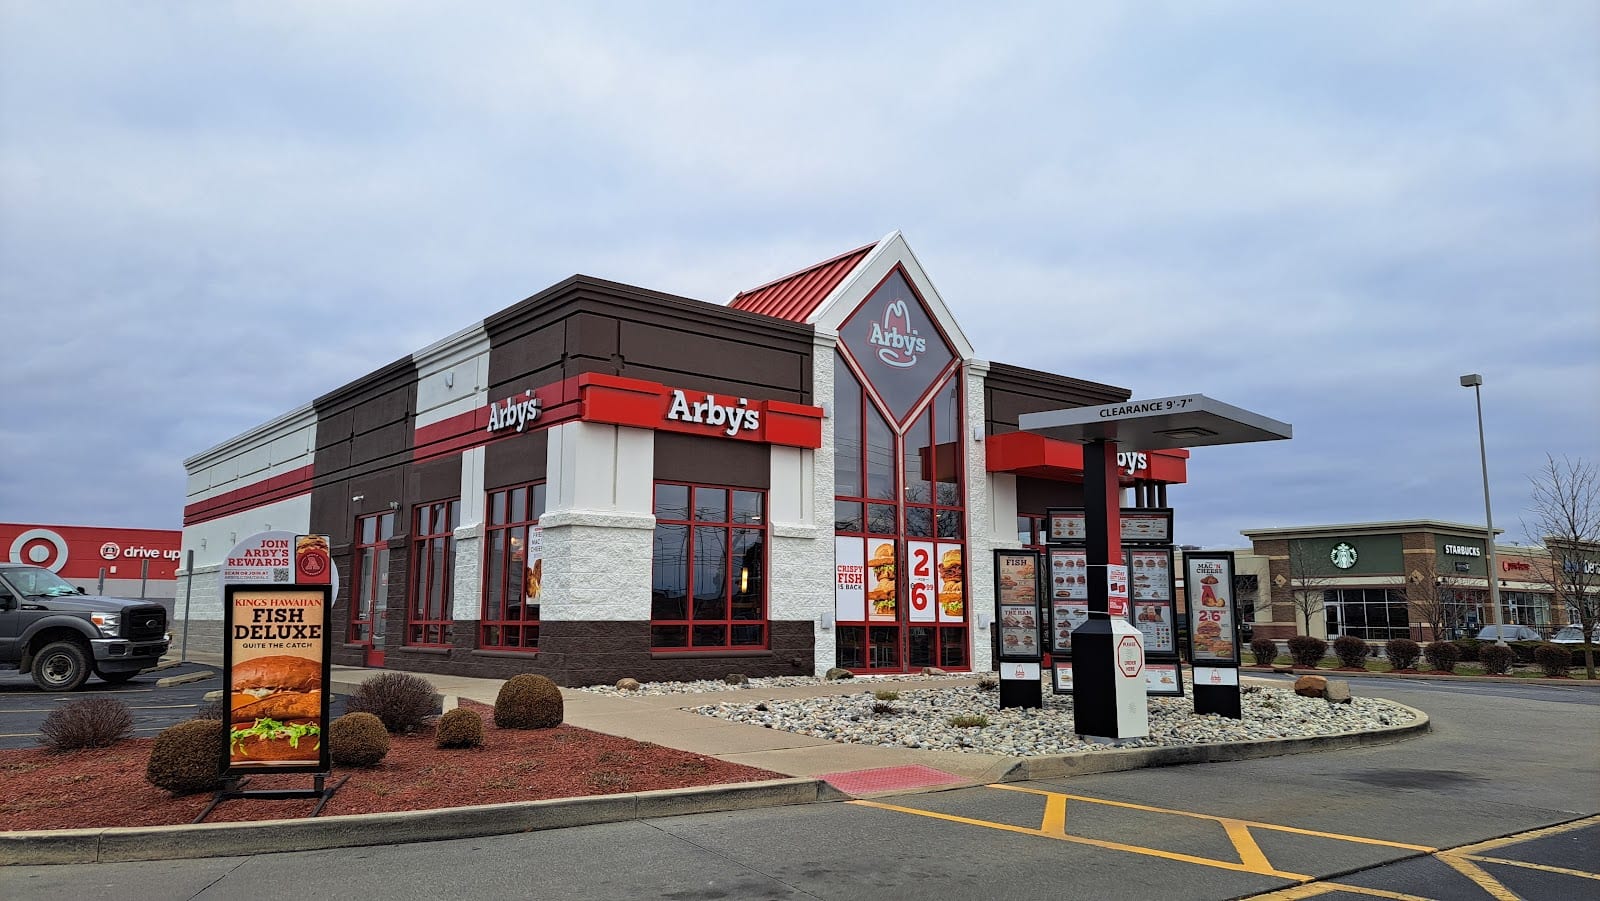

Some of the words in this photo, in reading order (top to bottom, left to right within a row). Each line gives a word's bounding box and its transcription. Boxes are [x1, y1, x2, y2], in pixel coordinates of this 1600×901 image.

[870, 323, 926, 355] Arby's
[486, 389, 539, 432] Arby's
[667, 389, 760, 436] Arby's
[1100, 402, 1163, 418] CLEARANCE
[260, 540, 289, 549] JOIN
[1445, 544, 1481, 557] STARBUCKS
[123, 546, 160, 558] drive
[163, 549, 181, 561] up
[244, 549, 289, 558] ARBY'S
[228, 558, 289, 567] REWARDS
[837, 565, 863, 573] CRISPY
[913, 548, 929, 577] 2
[837, 573, 863, 584] FISH
[270, 599, 322, 607] HAWAIIAN
[911, 582, 927, 611] 6
[252, 608, 304, 623] FISH
[234, 624, 321, 640] DELUXE
